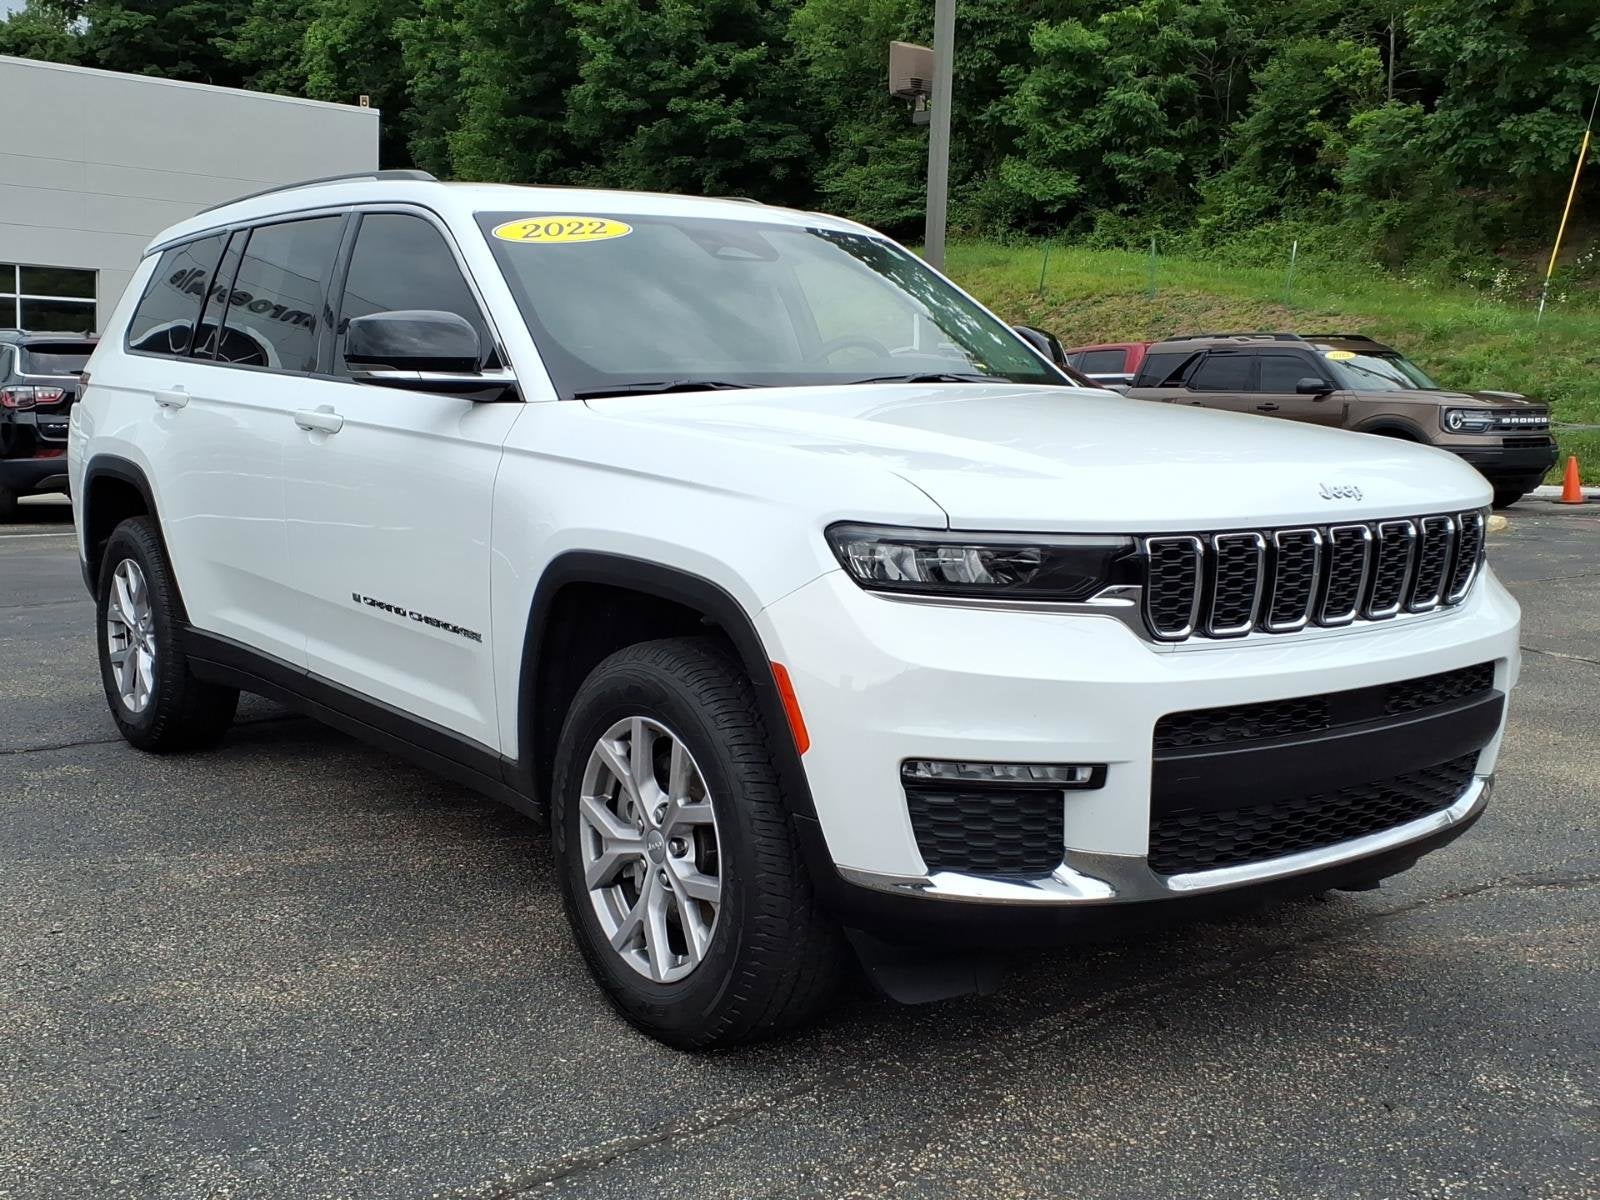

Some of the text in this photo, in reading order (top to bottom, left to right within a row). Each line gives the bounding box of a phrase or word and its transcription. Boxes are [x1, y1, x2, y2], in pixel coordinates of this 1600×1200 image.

[521, 221, 608, 239] 2022
[1318, 482, 1364, 502] Jeep
[363, 596, 482, 643] GRAND CHEROKEE
